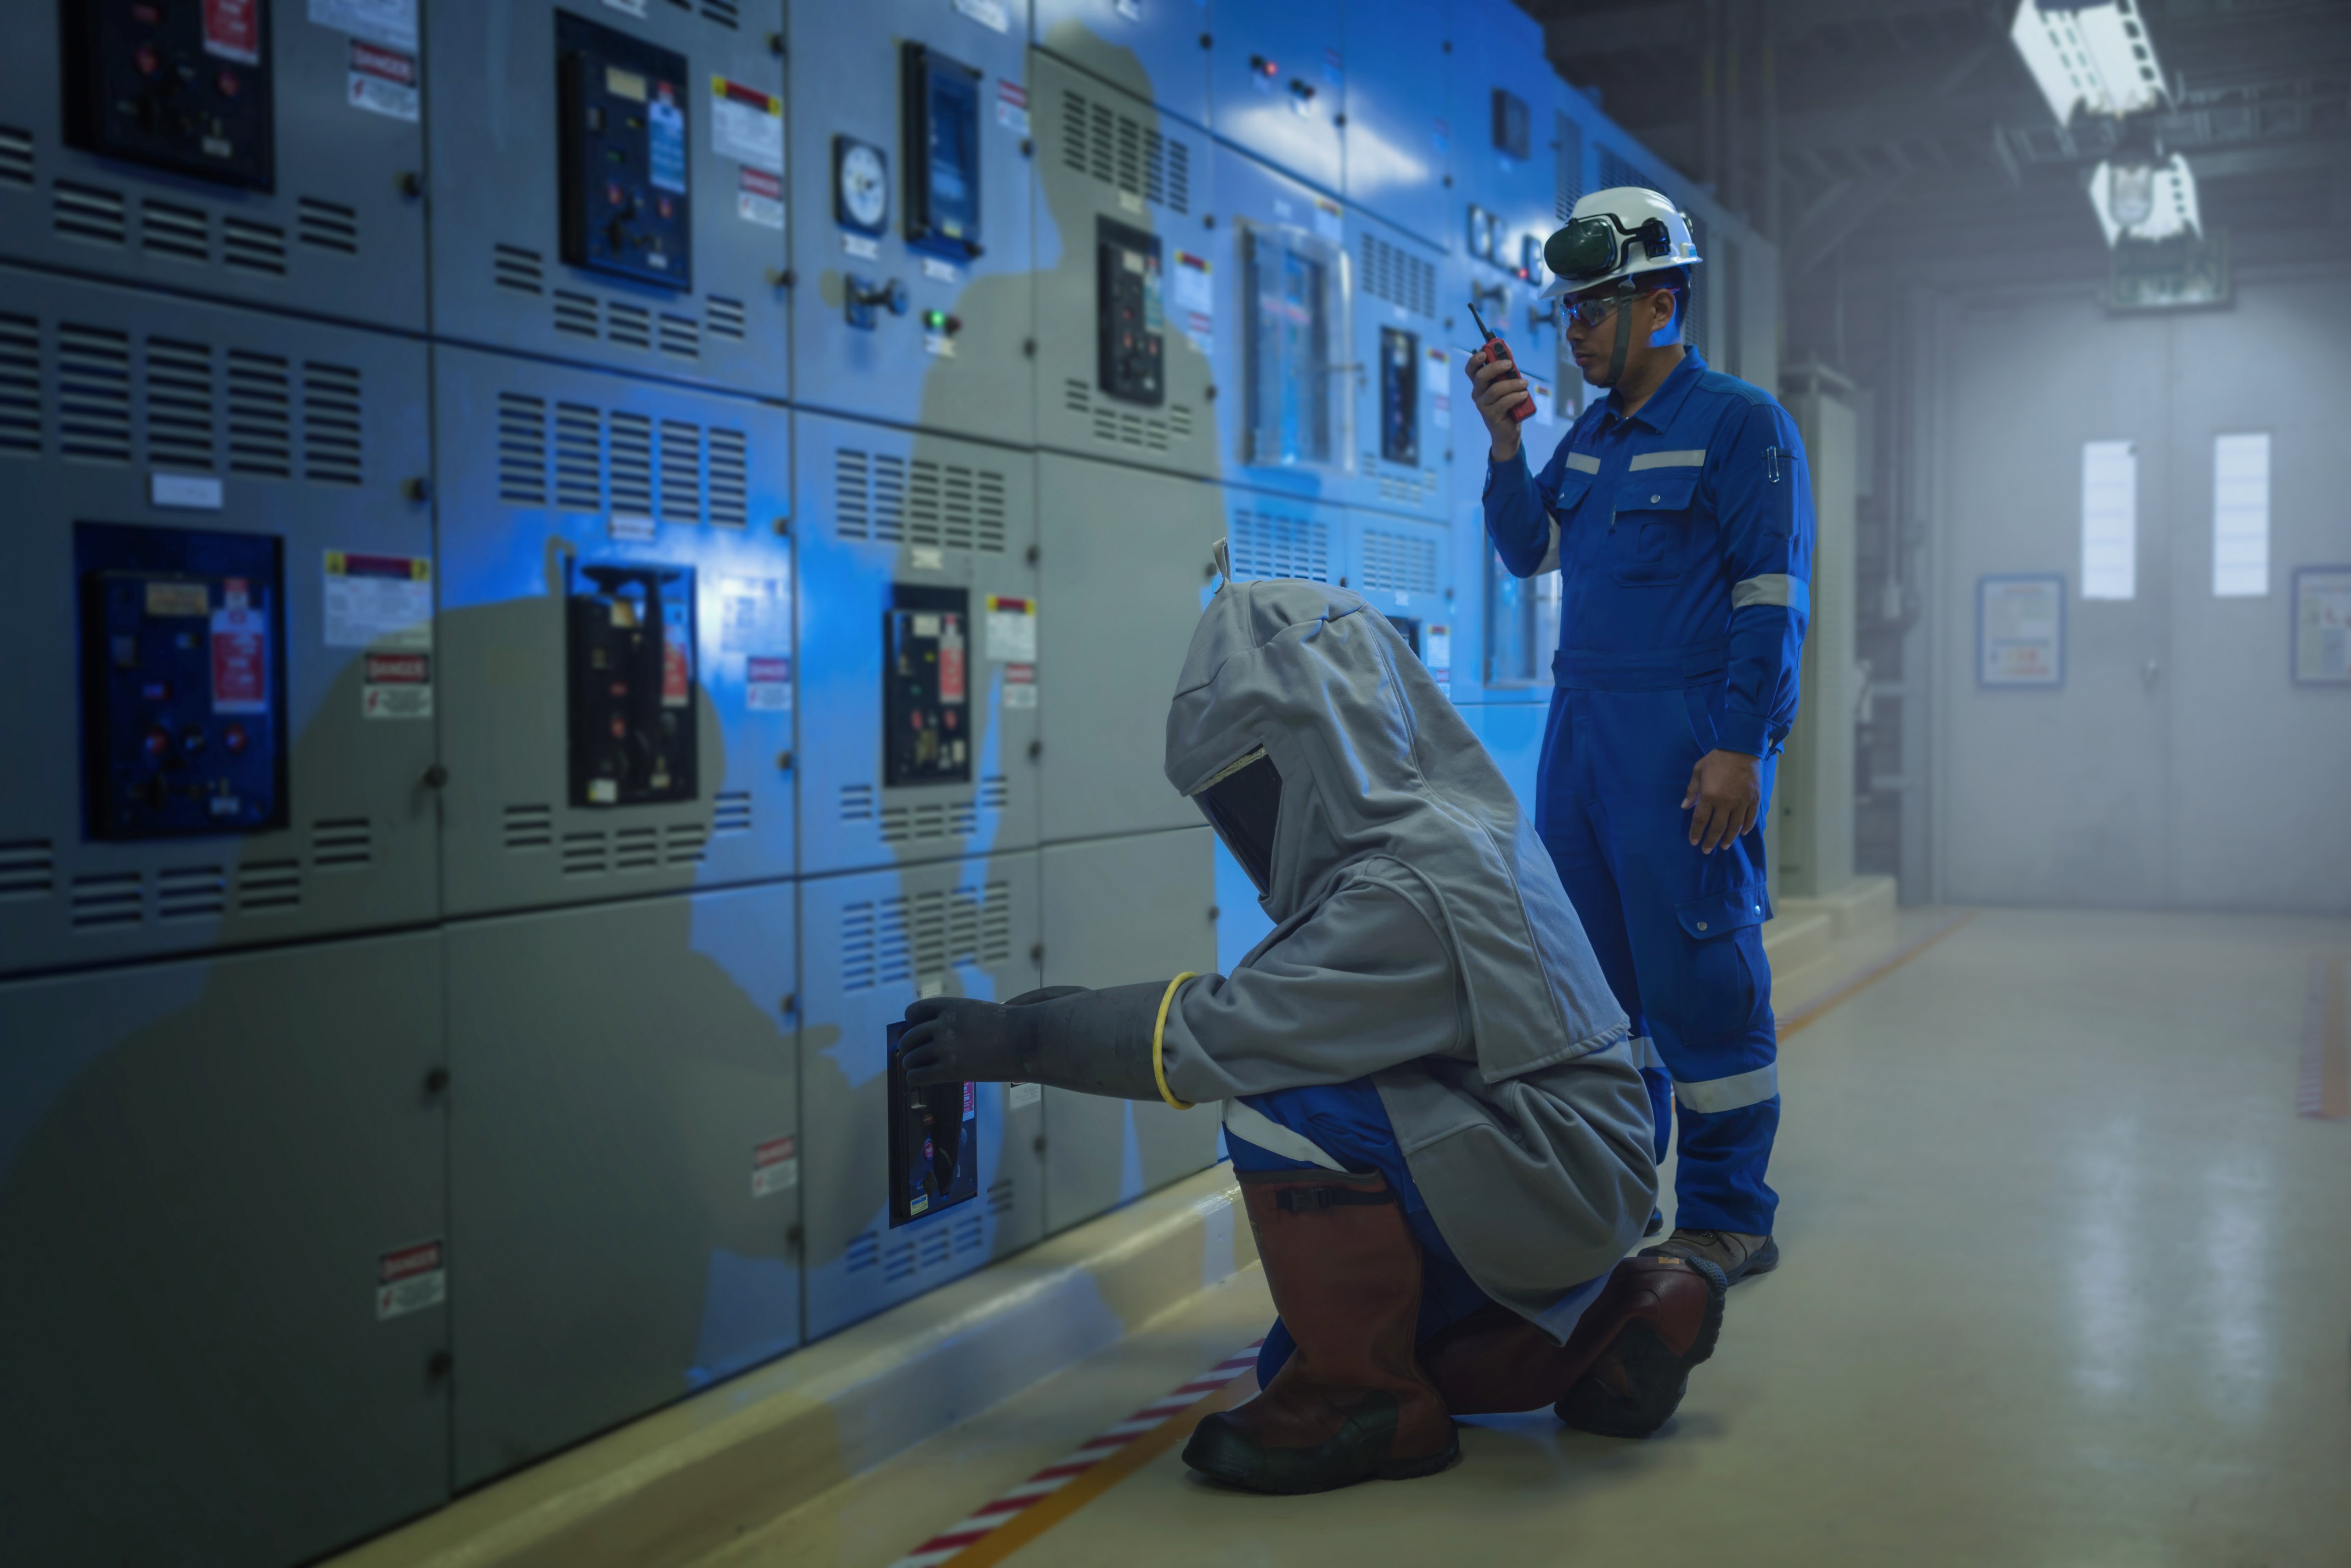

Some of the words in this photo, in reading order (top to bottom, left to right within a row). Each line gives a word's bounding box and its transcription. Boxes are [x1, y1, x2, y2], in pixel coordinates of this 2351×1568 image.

[354, 49, 410, 78] DANGER
[369, 660, 424, 677] DANGER
[385, 1249, 437, 1275] DANGER
